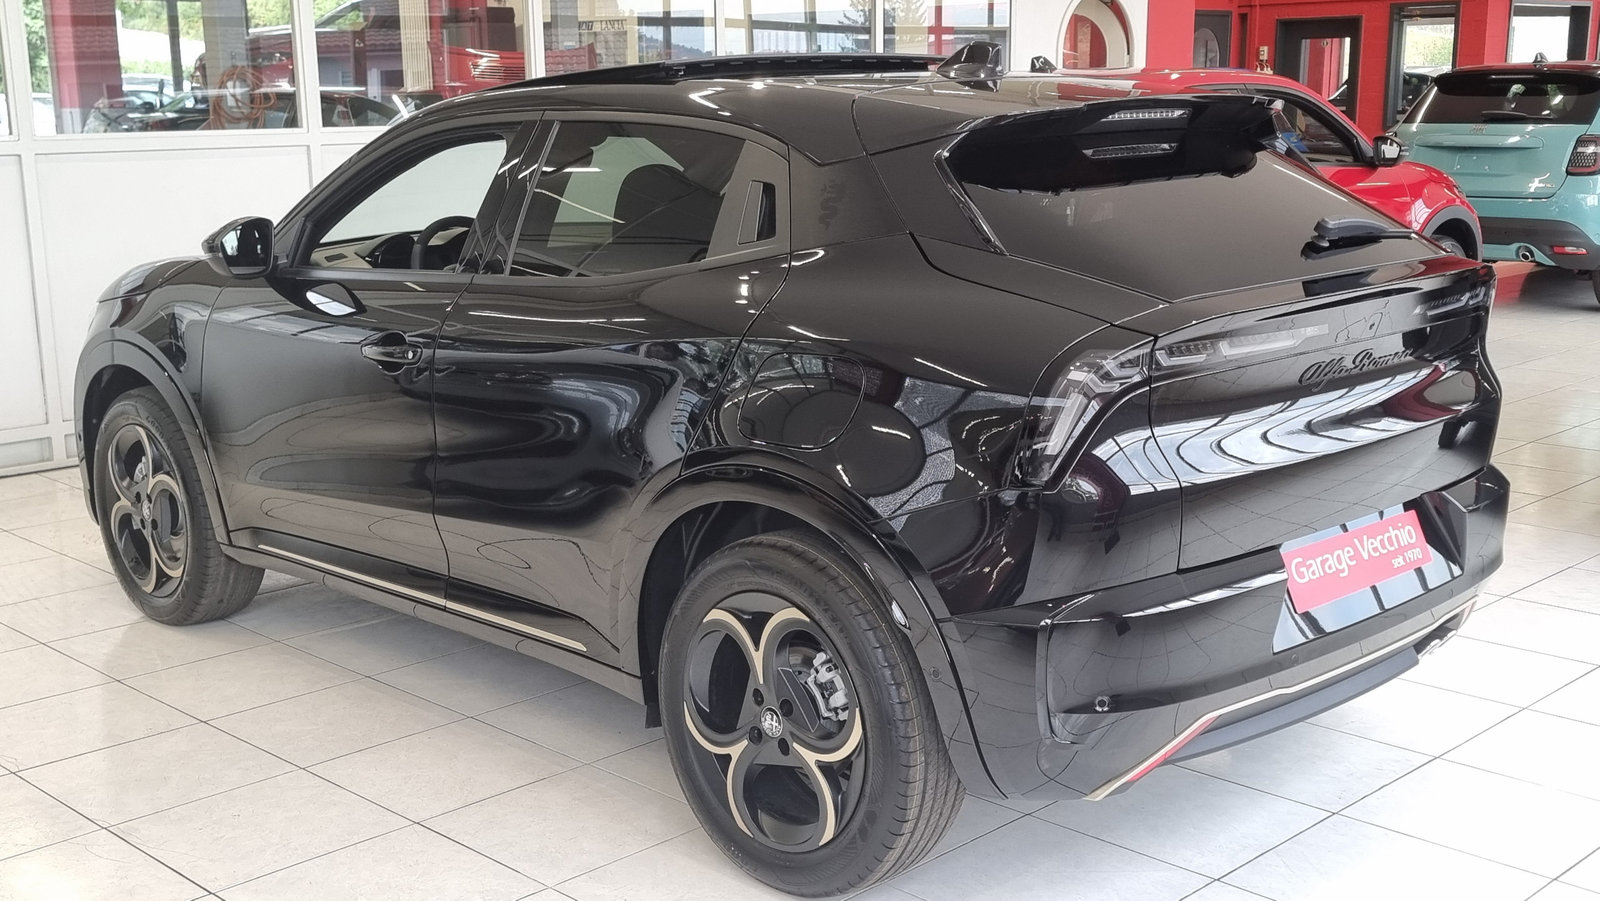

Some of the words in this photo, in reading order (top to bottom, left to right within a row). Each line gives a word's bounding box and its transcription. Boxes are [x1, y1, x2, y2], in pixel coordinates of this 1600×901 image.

[600, 19, 625, 31] LANCIA
[1298, 356, 1350, 392] Alfa
[1291, 546, 1357, 584] Garage
[1353, 522, 1417, 560] Vecchio
[1391, 554, 1406, 569] seit
[1404, 547, 1423, 564] 1970
